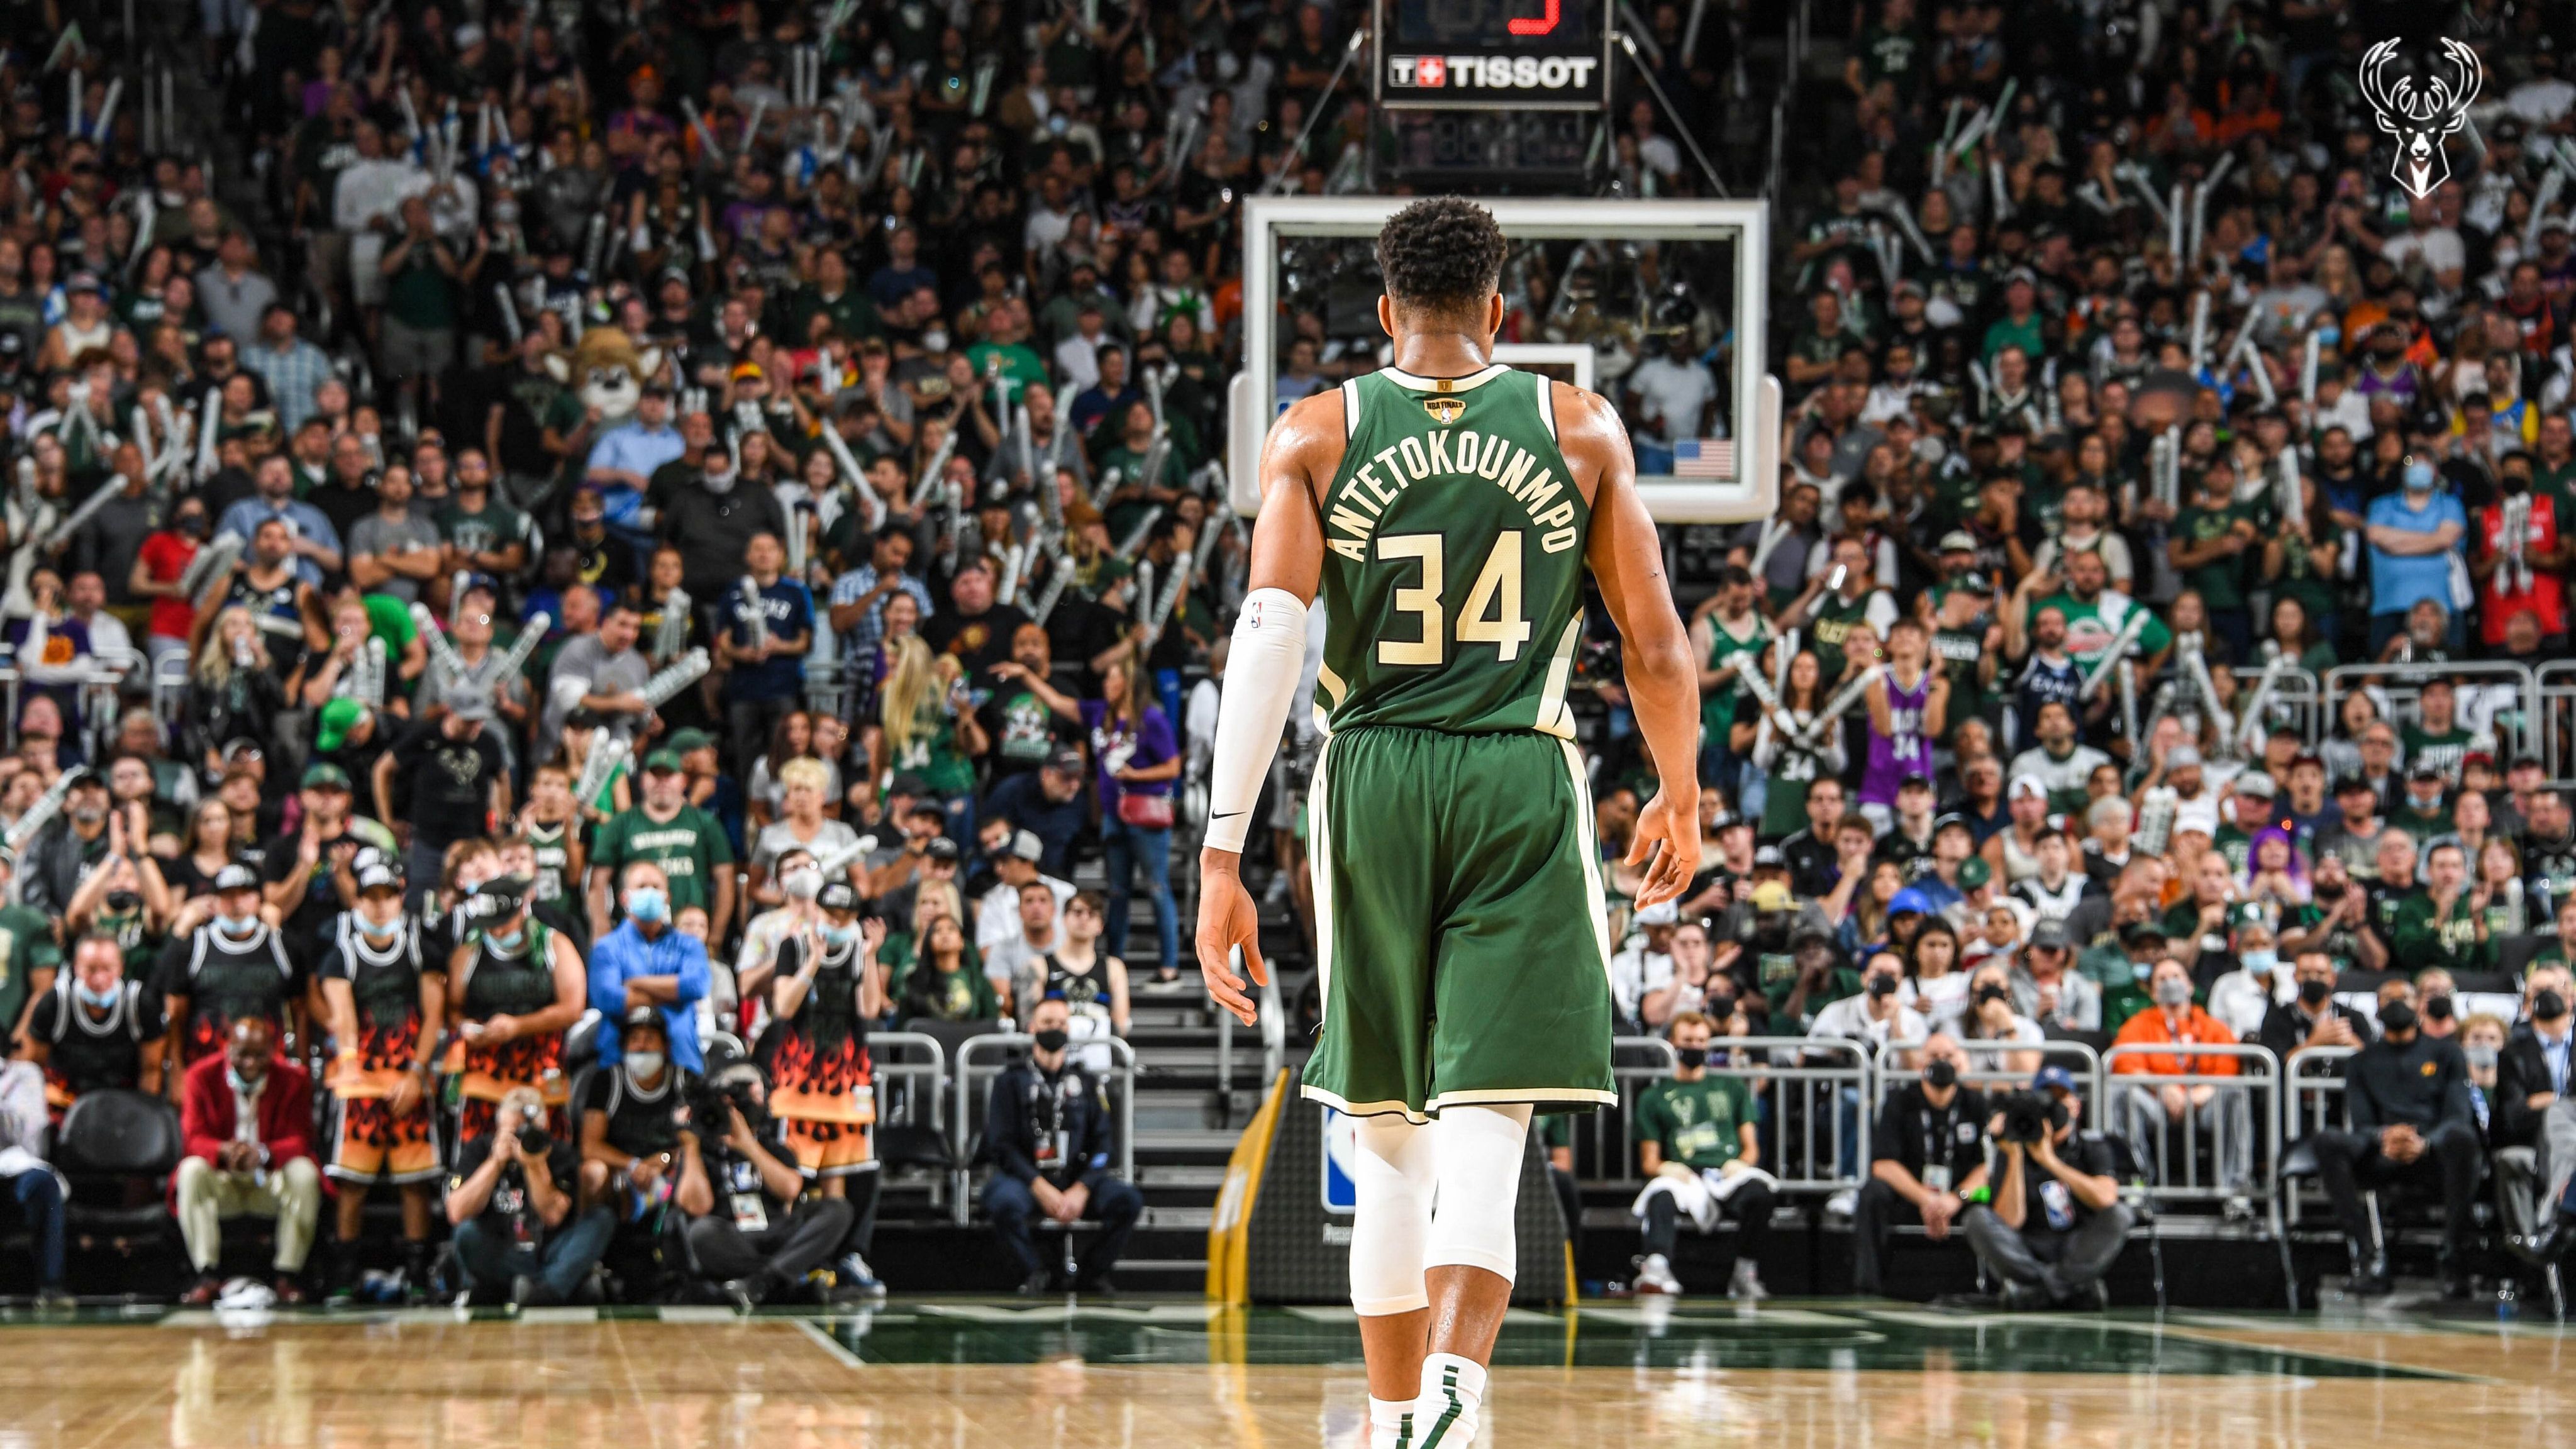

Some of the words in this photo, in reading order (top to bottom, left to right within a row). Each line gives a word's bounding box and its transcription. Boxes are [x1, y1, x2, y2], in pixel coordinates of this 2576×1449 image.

[1447, 55, 1598, 89] TISSOT
[1326, 430, 1577, 563] ANTETOKOUNMPO
[1376, 529, 1533, 665] 34
[1780, 750, 1816, 782] 34
